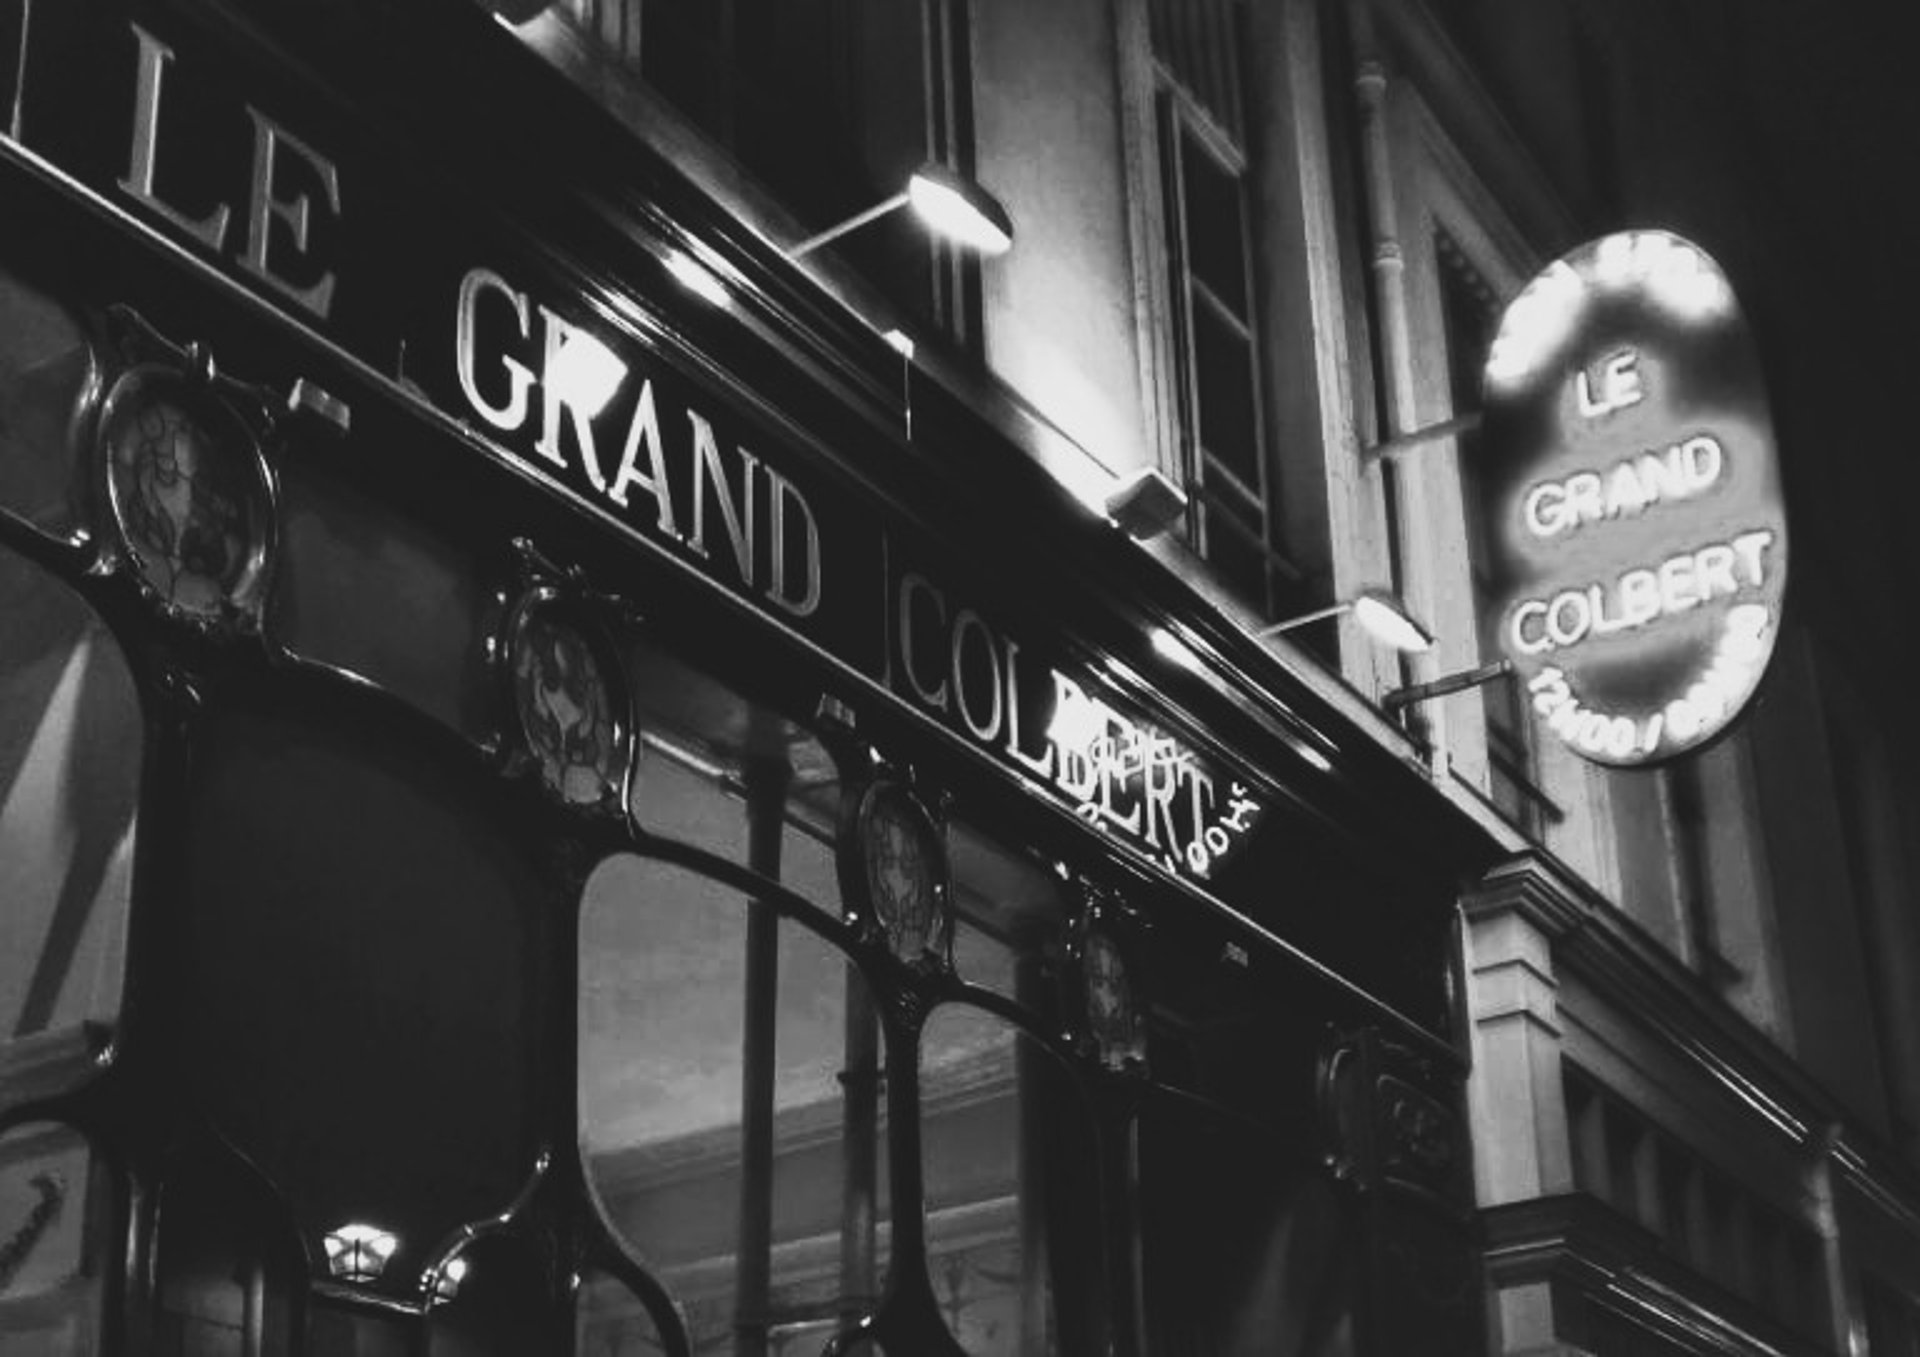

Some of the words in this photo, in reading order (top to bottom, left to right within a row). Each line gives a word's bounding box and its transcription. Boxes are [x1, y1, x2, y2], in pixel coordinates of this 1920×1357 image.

[1576, 351, 1643, 418] LE
[117, 21, 341, 319] LE
[457, 267, 821, 617] GRAND
[900, 572, 1213, 878] COLBERT
[1525, 436, 1721, 537] GRAND
[1511, 531, 1771, 655] COLBERT
